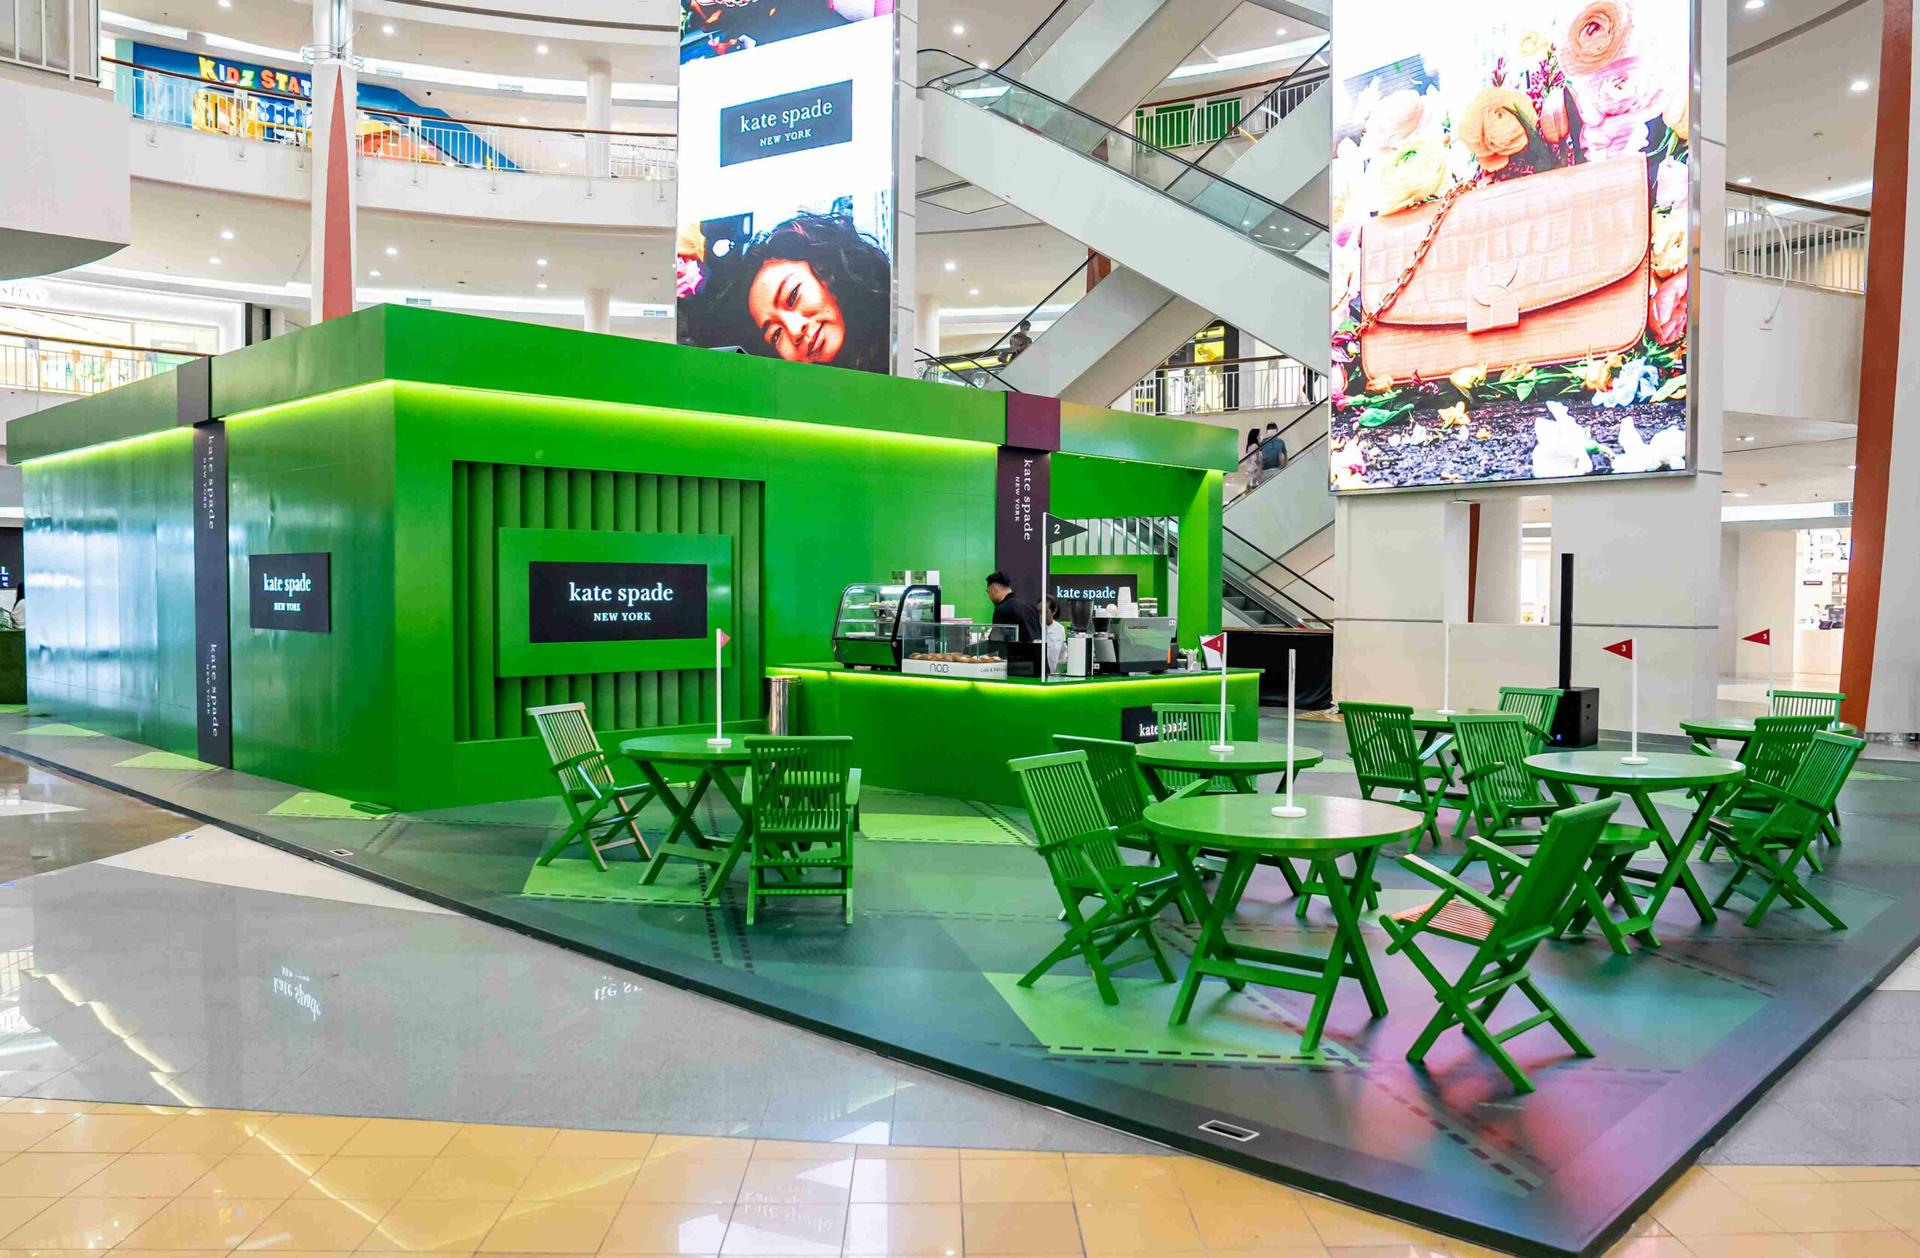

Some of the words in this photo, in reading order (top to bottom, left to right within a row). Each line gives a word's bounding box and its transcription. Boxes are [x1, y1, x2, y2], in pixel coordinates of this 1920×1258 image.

[199, 56, 255, 88] KIDZ
[740, 113, 777, 133] kate
[782, 98, 833, 128] spade
[760, 135, 781, 147] NEW
[785, 128, 812, 142] YORK
[1023, 459, 1033, 492] kate
[1021, 496, 1033, 541] spade
[1054, 524, 1060, 535] 2
[263, 573, 283, 592] kate
[284, 572, 312, 597] spade
[569, 582, 613, 601] kate
[617, 582, 674, 607] spade
[1056, 586, 1080, 598] kate
[1082, 586, 1116, 600] spade
[593, 612, 618, 621] NEW
[621, 612, 651, 621] YORK
[1139, 723, 1159, 737] kate
